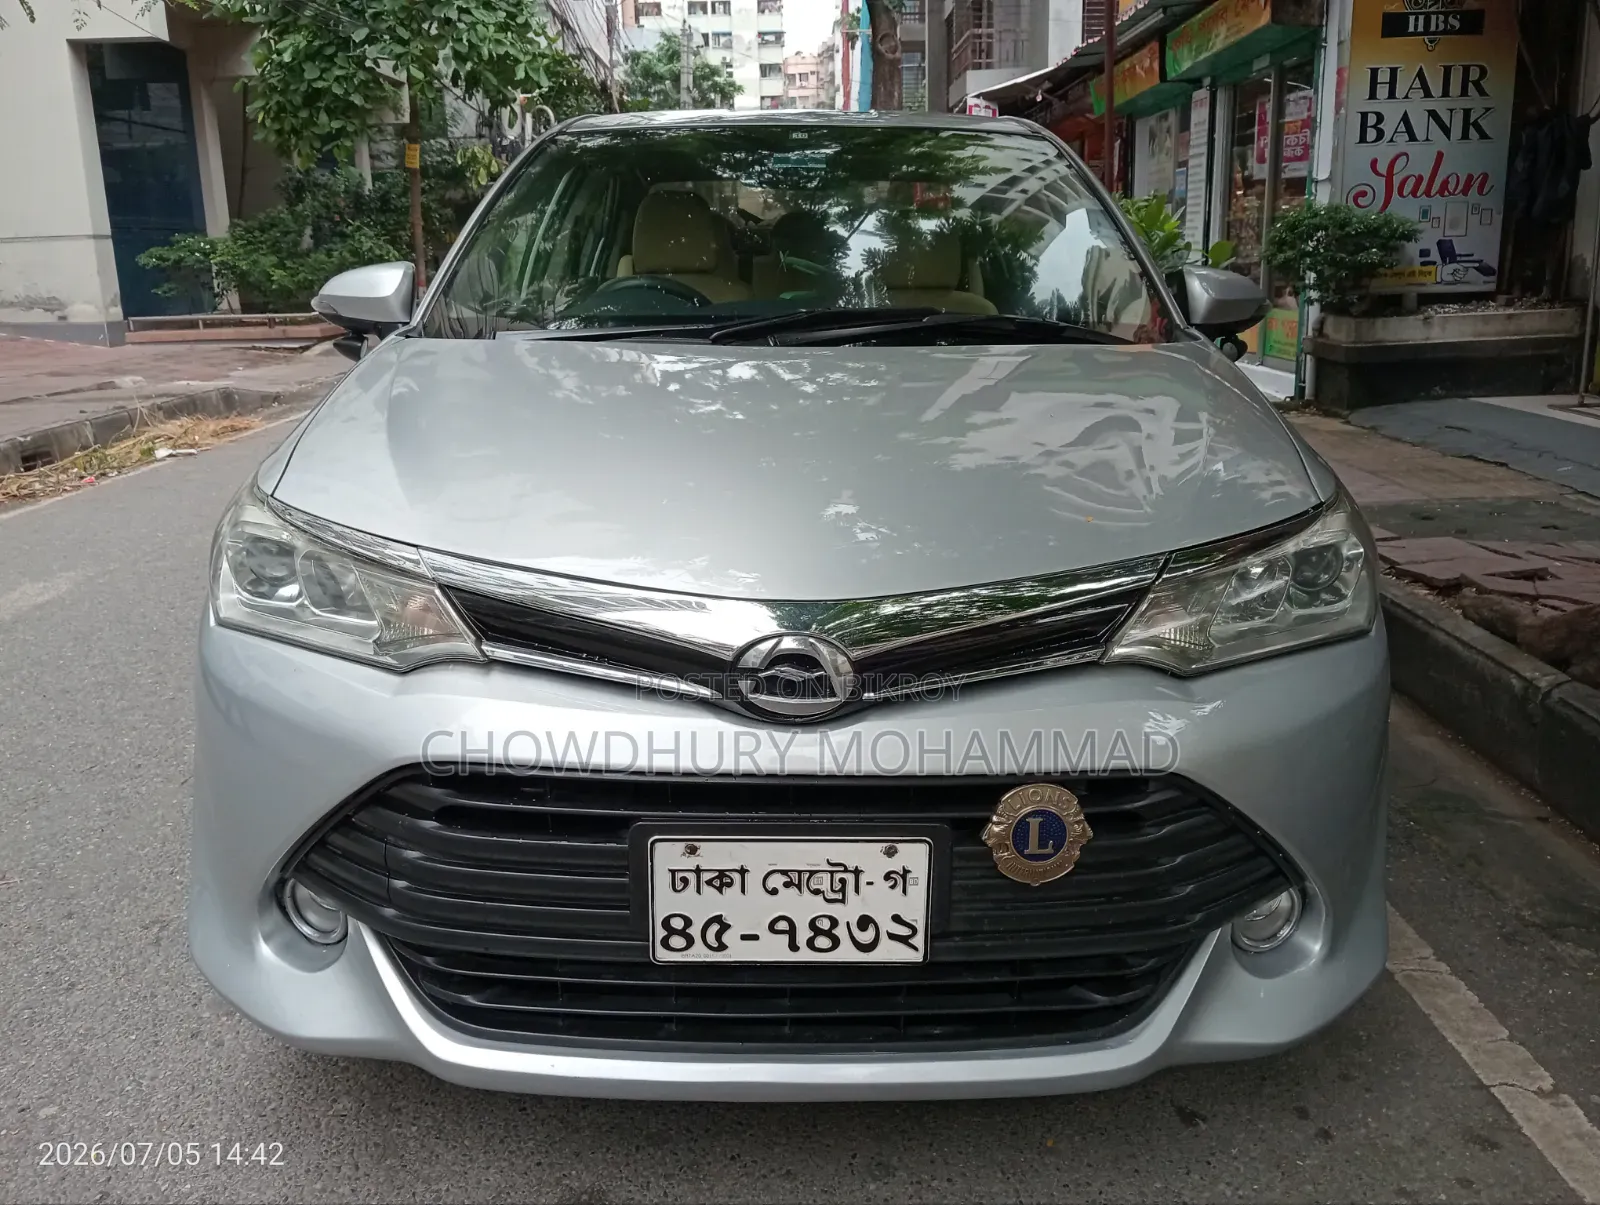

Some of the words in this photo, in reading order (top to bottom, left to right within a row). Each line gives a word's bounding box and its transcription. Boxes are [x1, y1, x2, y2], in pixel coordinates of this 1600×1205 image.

[1407, 14, 1461, 33] HBS
[1365, 64, 1491, 101] HAIR
[1355, 107, 1496, 144] BANK
[1346, 150, 1495, 213] Salon
[1008, 788, 1073, 810] LIONS
[1024, 818, 1054, 854] L
[668, 864, 750, 896] ঢাকা
[660, 913, 919, 953] ৪৫-৭৪৩২
